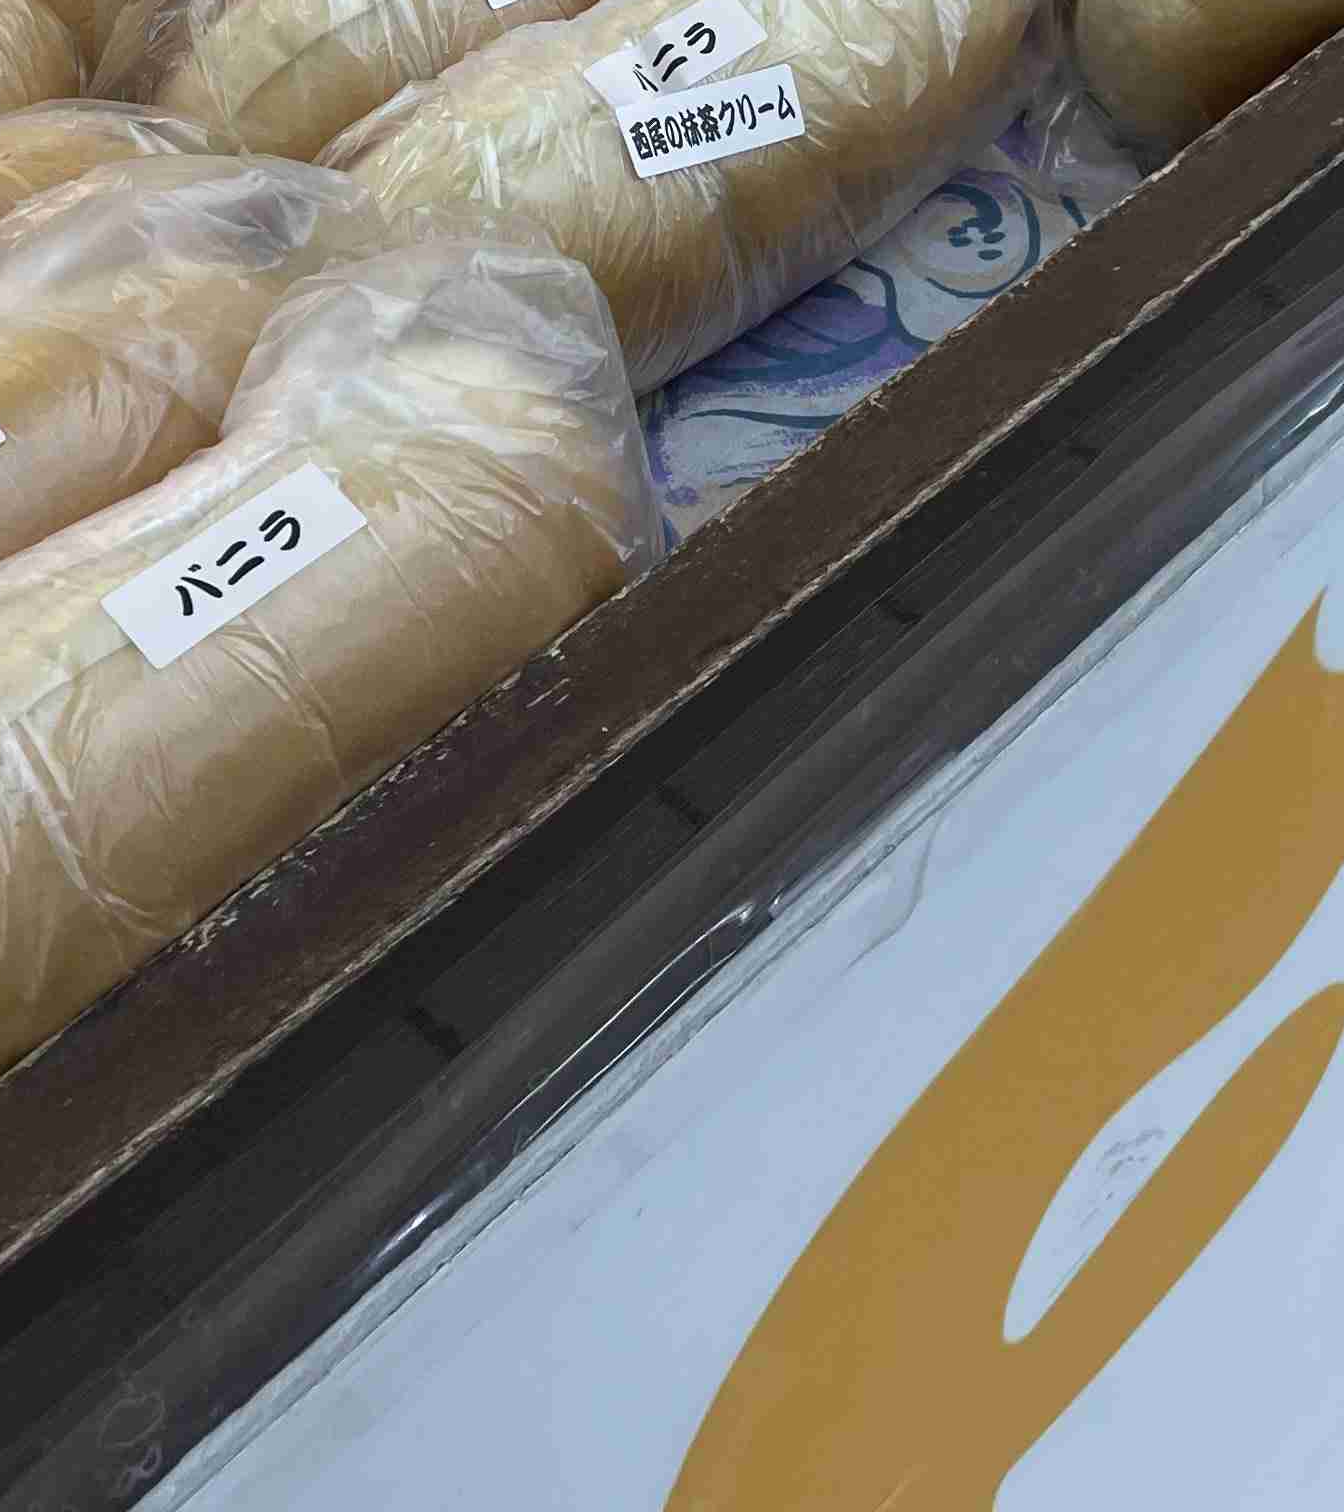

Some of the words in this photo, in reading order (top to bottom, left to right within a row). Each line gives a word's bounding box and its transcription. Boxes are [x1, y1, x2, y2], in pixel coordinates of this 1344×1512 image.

[632, 20, 718, 92] バニラ
[628, 84, 796, 161] 西尾の抹茶クリーム
[175, 509, 301, 617] バニラ
